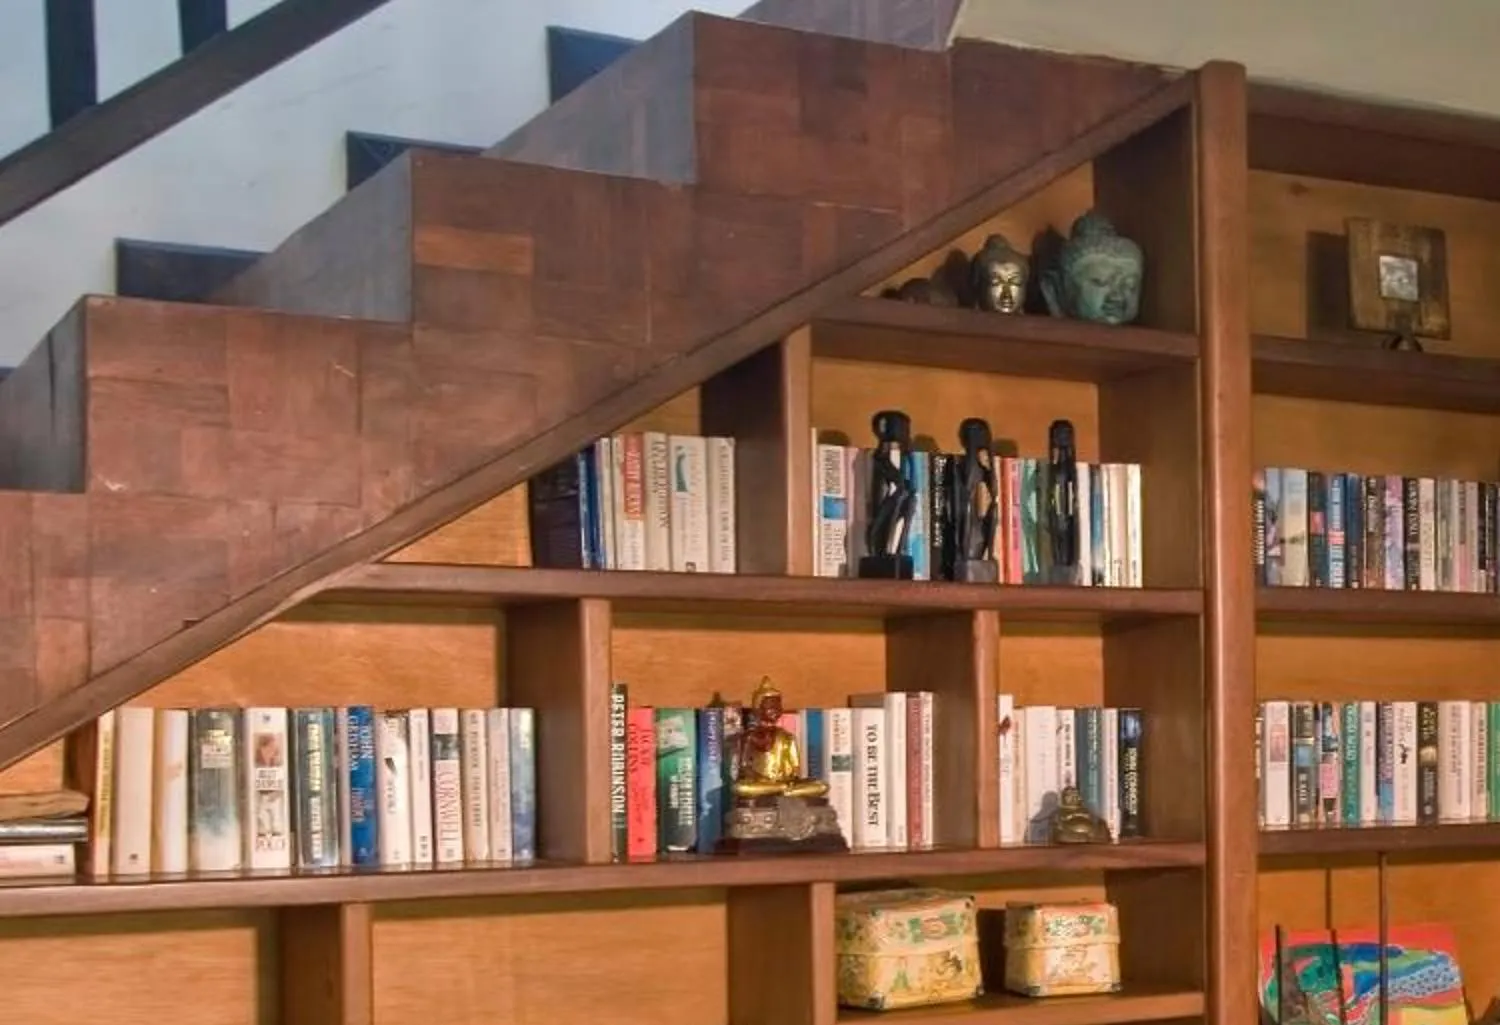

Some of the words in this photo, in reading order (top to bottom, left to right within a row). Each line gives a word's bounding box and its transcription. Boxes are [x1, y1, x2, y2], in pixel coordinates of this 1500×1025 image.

[611, 693, 625, 737] PETER
[867, 723, 879, 743] TO
[867, 745, 879, 761] BE
[611, 743, 625, 813] ROBINSON
[867, 765, 879, 788] THE
[867, 791, 881, 827] BEST
